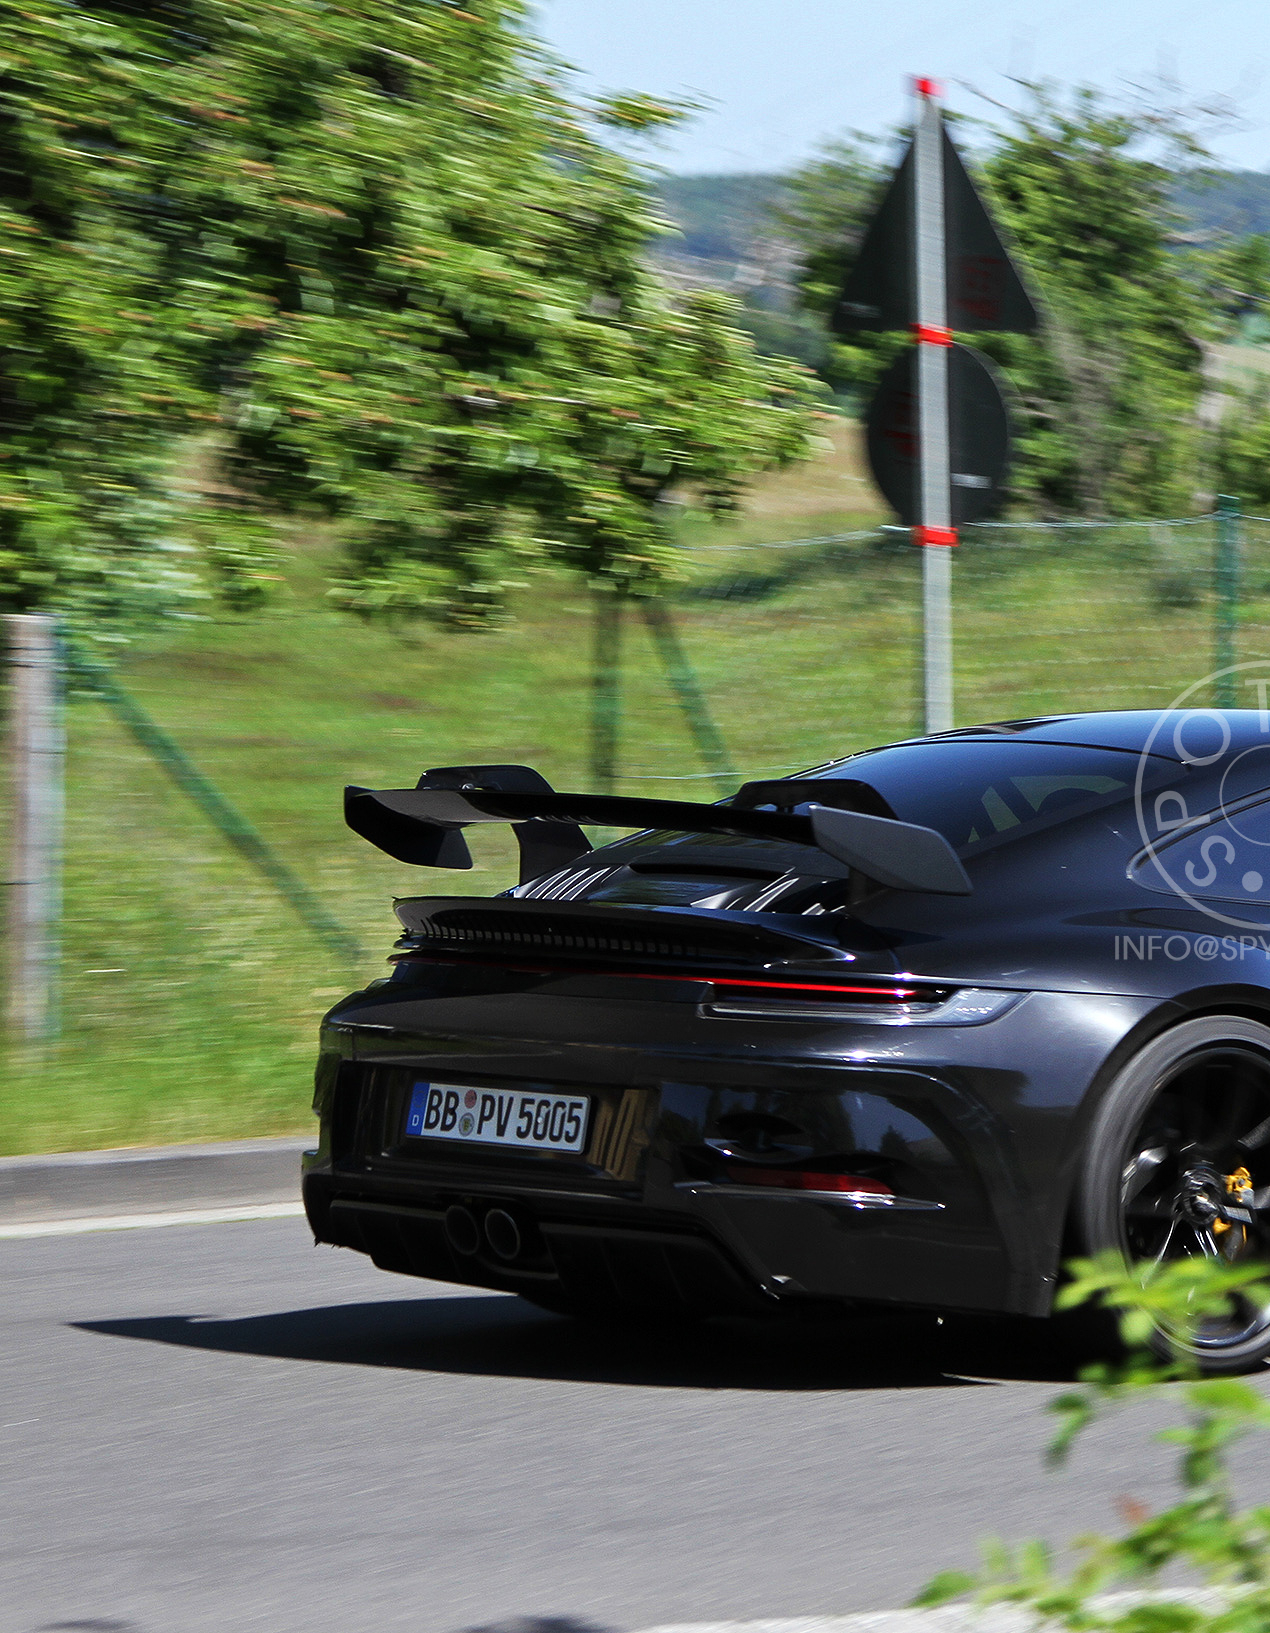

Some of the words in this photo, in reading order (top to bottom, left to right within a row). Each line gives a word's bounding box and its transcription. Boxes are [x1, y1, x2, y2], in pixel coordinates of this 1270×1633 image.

[411, 1114, 420, 1127] D
[423, 1089, 460, 1132] BB
[476, 1094, 515, 1137] PV
[516, 1097, 584, 1143] 5005
